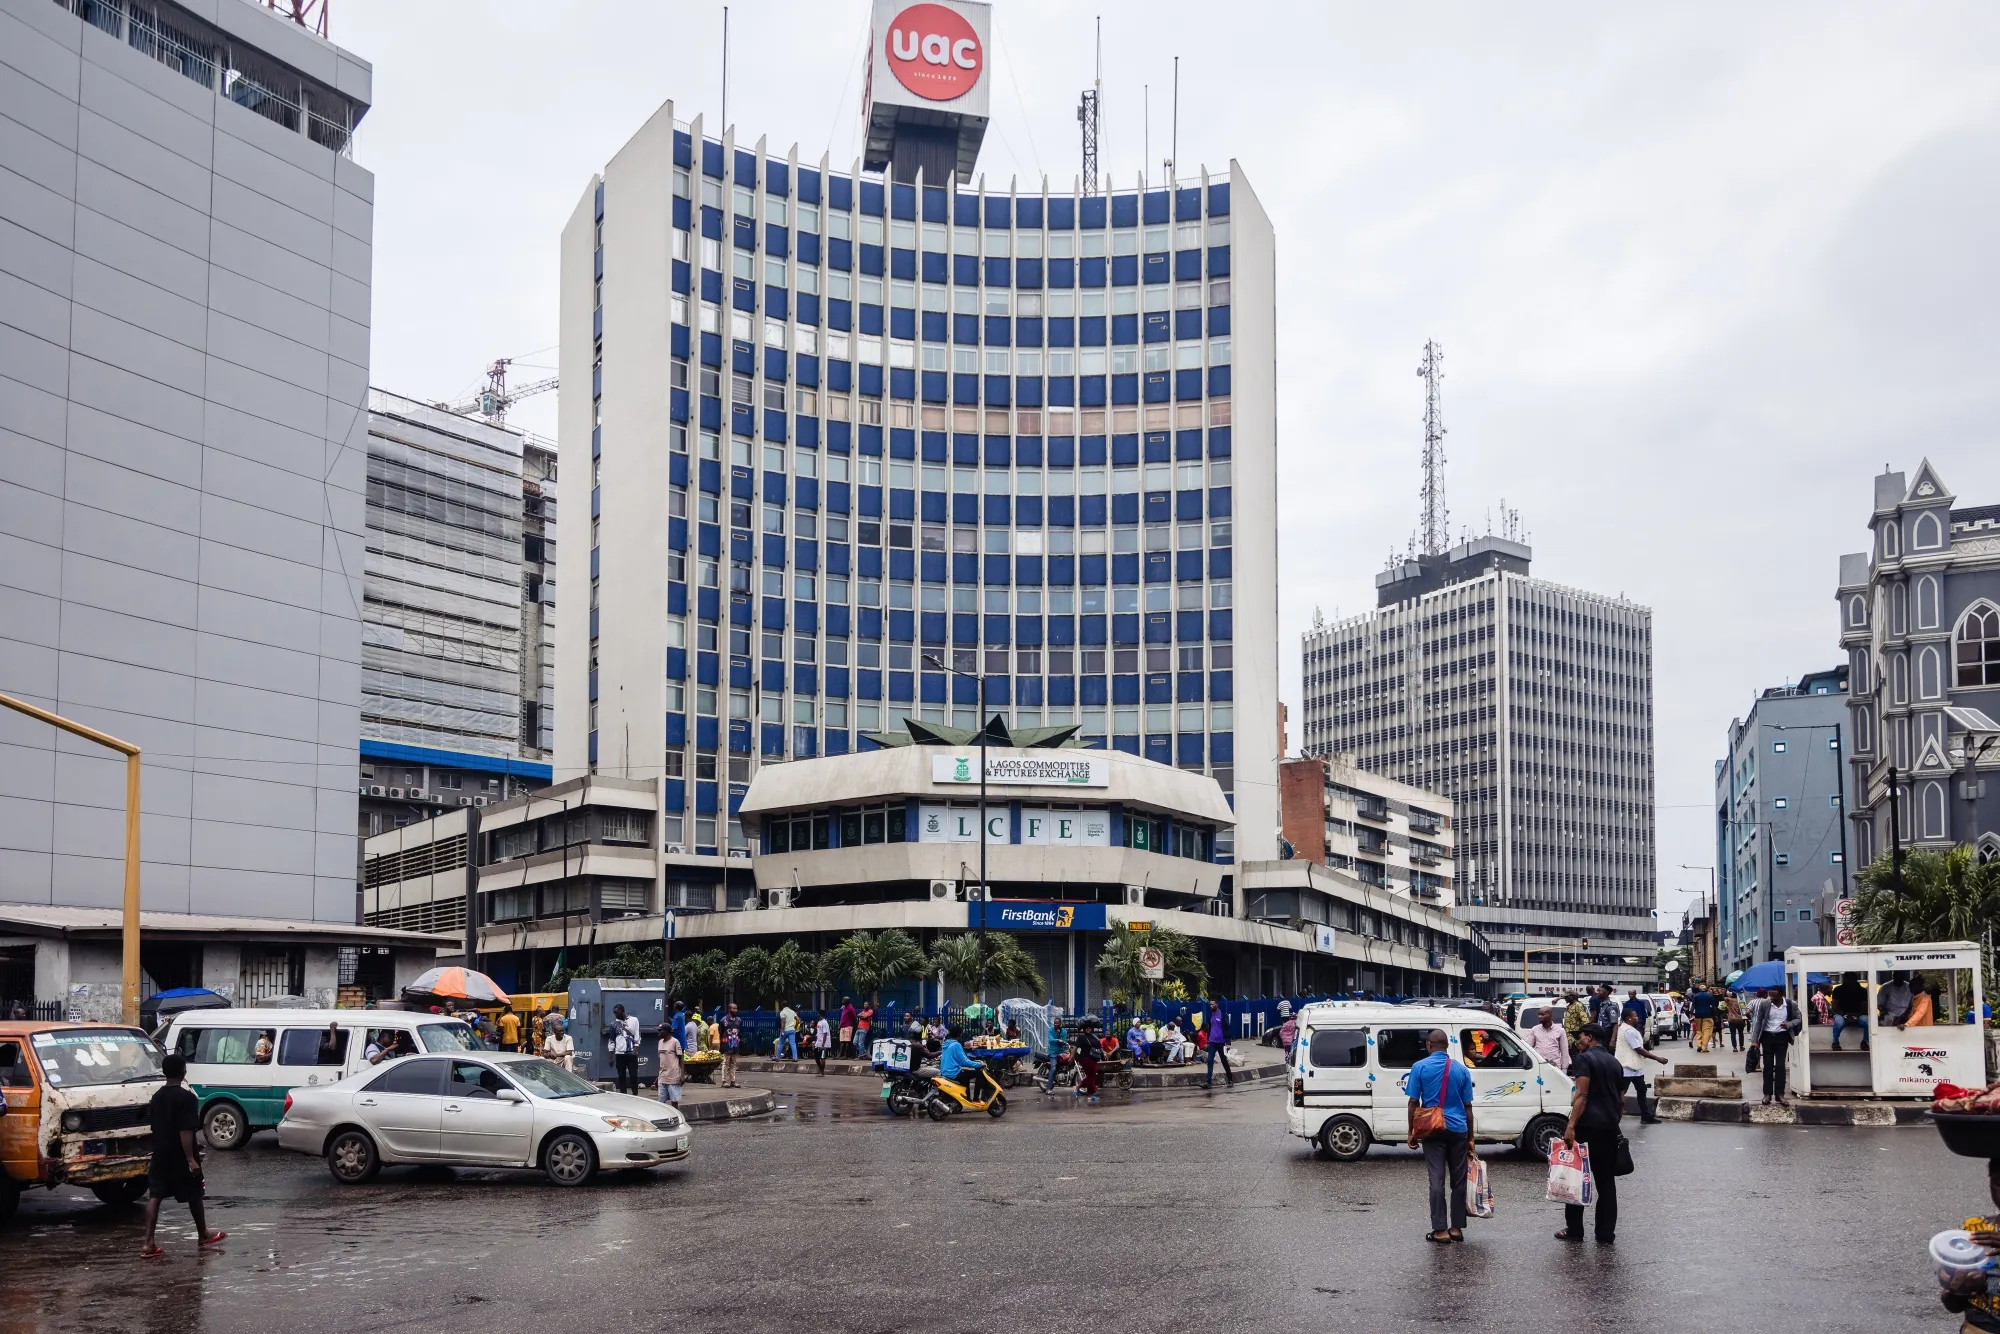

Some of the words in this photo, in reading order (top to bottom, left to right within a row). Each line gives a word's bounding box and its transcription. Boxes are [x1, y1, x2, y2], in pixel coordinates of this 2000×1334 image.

[892, 28, 976, 70] uac
[990, 760, 1021, 769] LAGOS
[1022, 760, 1090, 770] COMMODITIES
[985, 768, 992, 776] &
[994, 768, 1037, 777] FUTURES
[1039, 769, 1090, 778] EXCHANGE
[957, 816, 972, 836] L
[988, 817, 1003, 837] C
[1028, 818, 1041, 837] F
[1059, 819, 1072, 838] E
[1002, 908, 1056, 921] FirstBank
